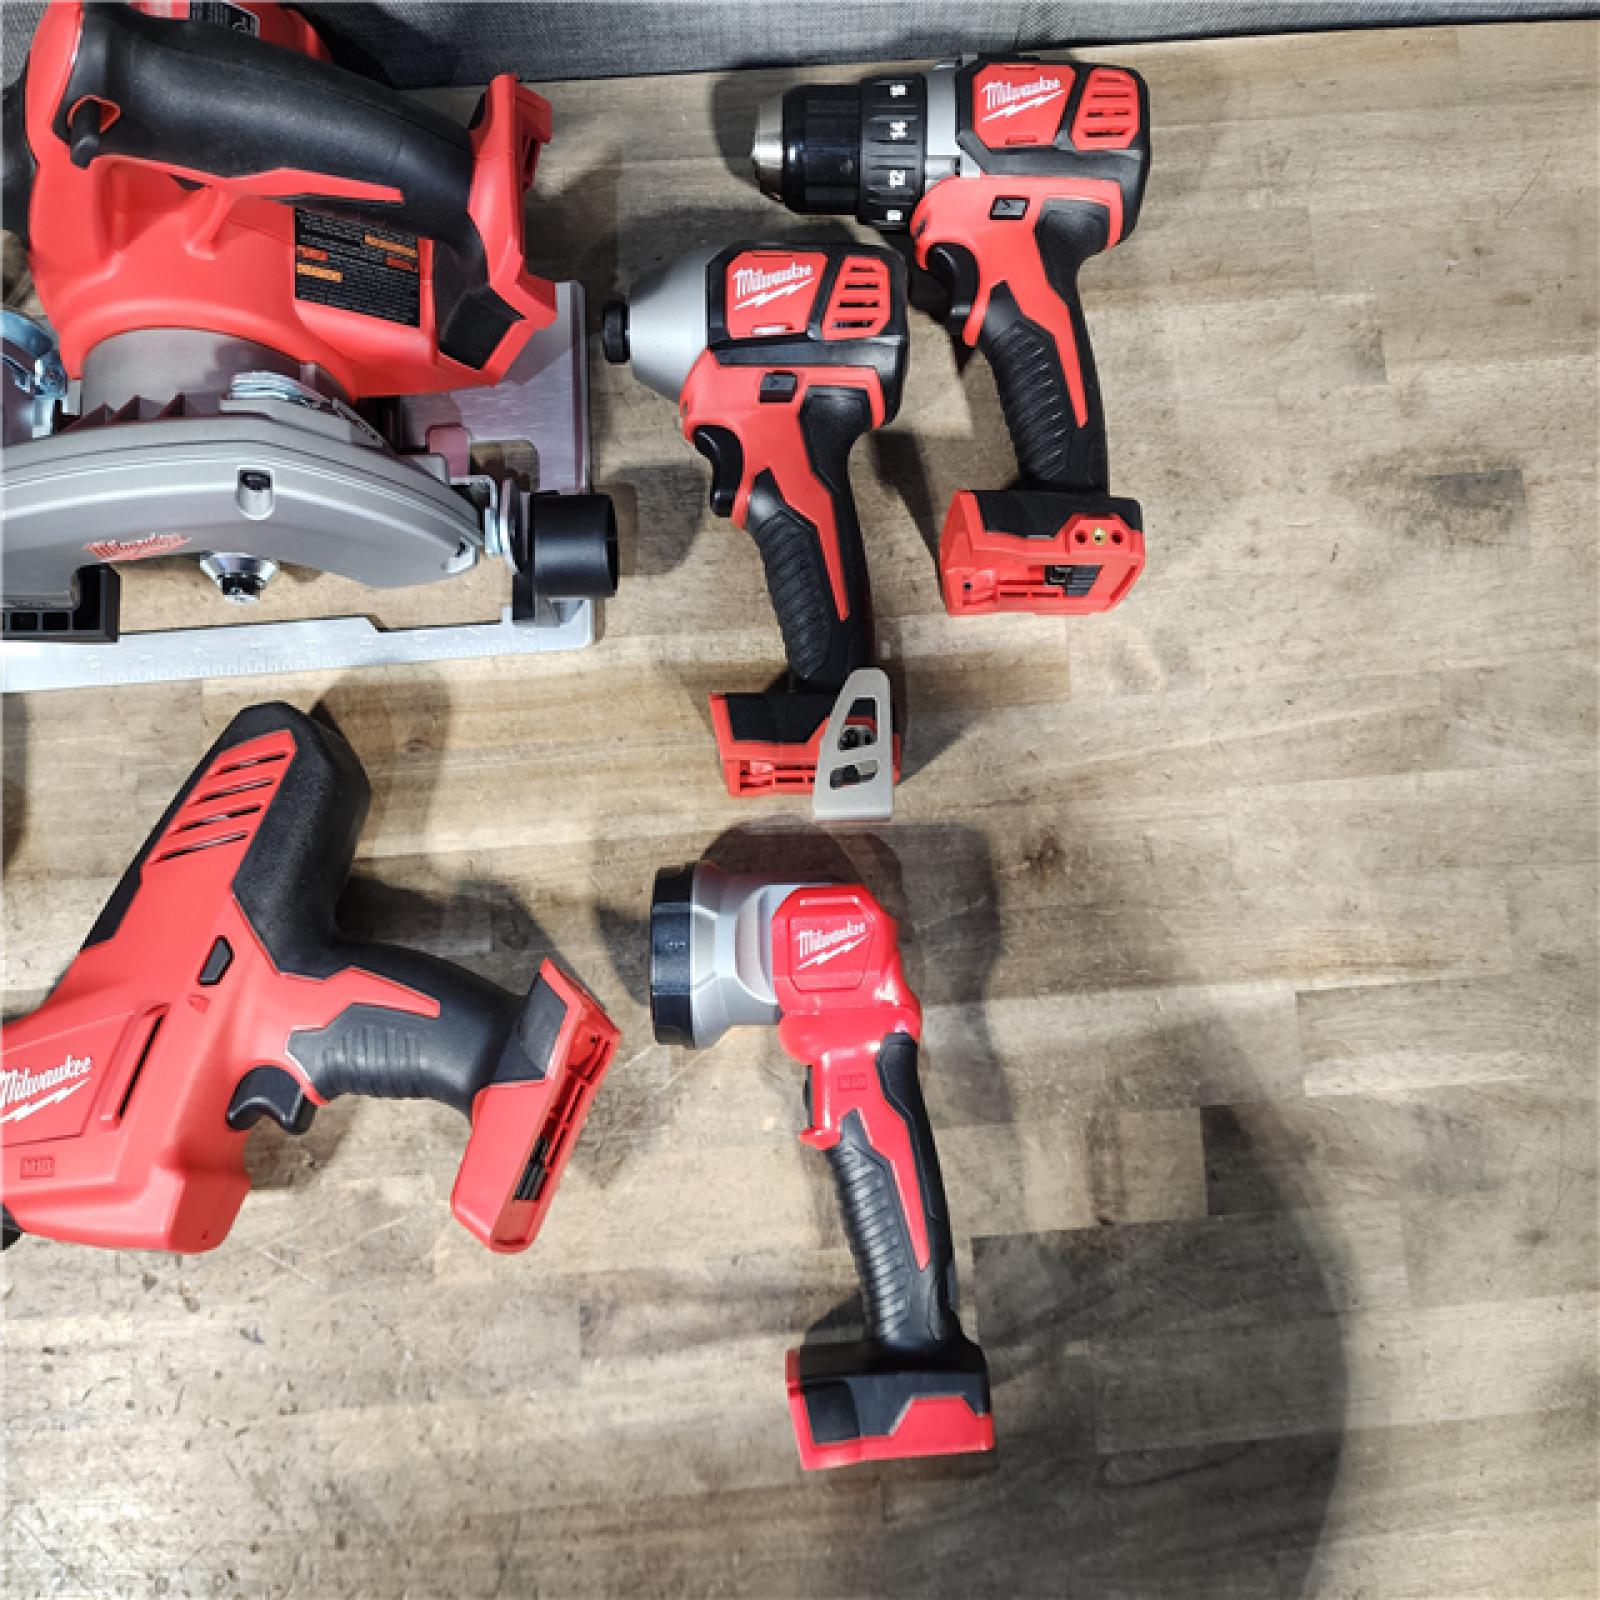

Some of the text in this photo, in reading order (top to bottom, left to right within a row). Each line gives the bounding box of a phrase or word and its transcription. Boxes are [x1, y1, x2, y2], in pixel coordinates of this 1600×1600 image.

[980, 75, 1061, 110] Milwaukee
[732, 262, 814, 299] Milwaukee
[794, 919, 867, 958] Milwaukee
